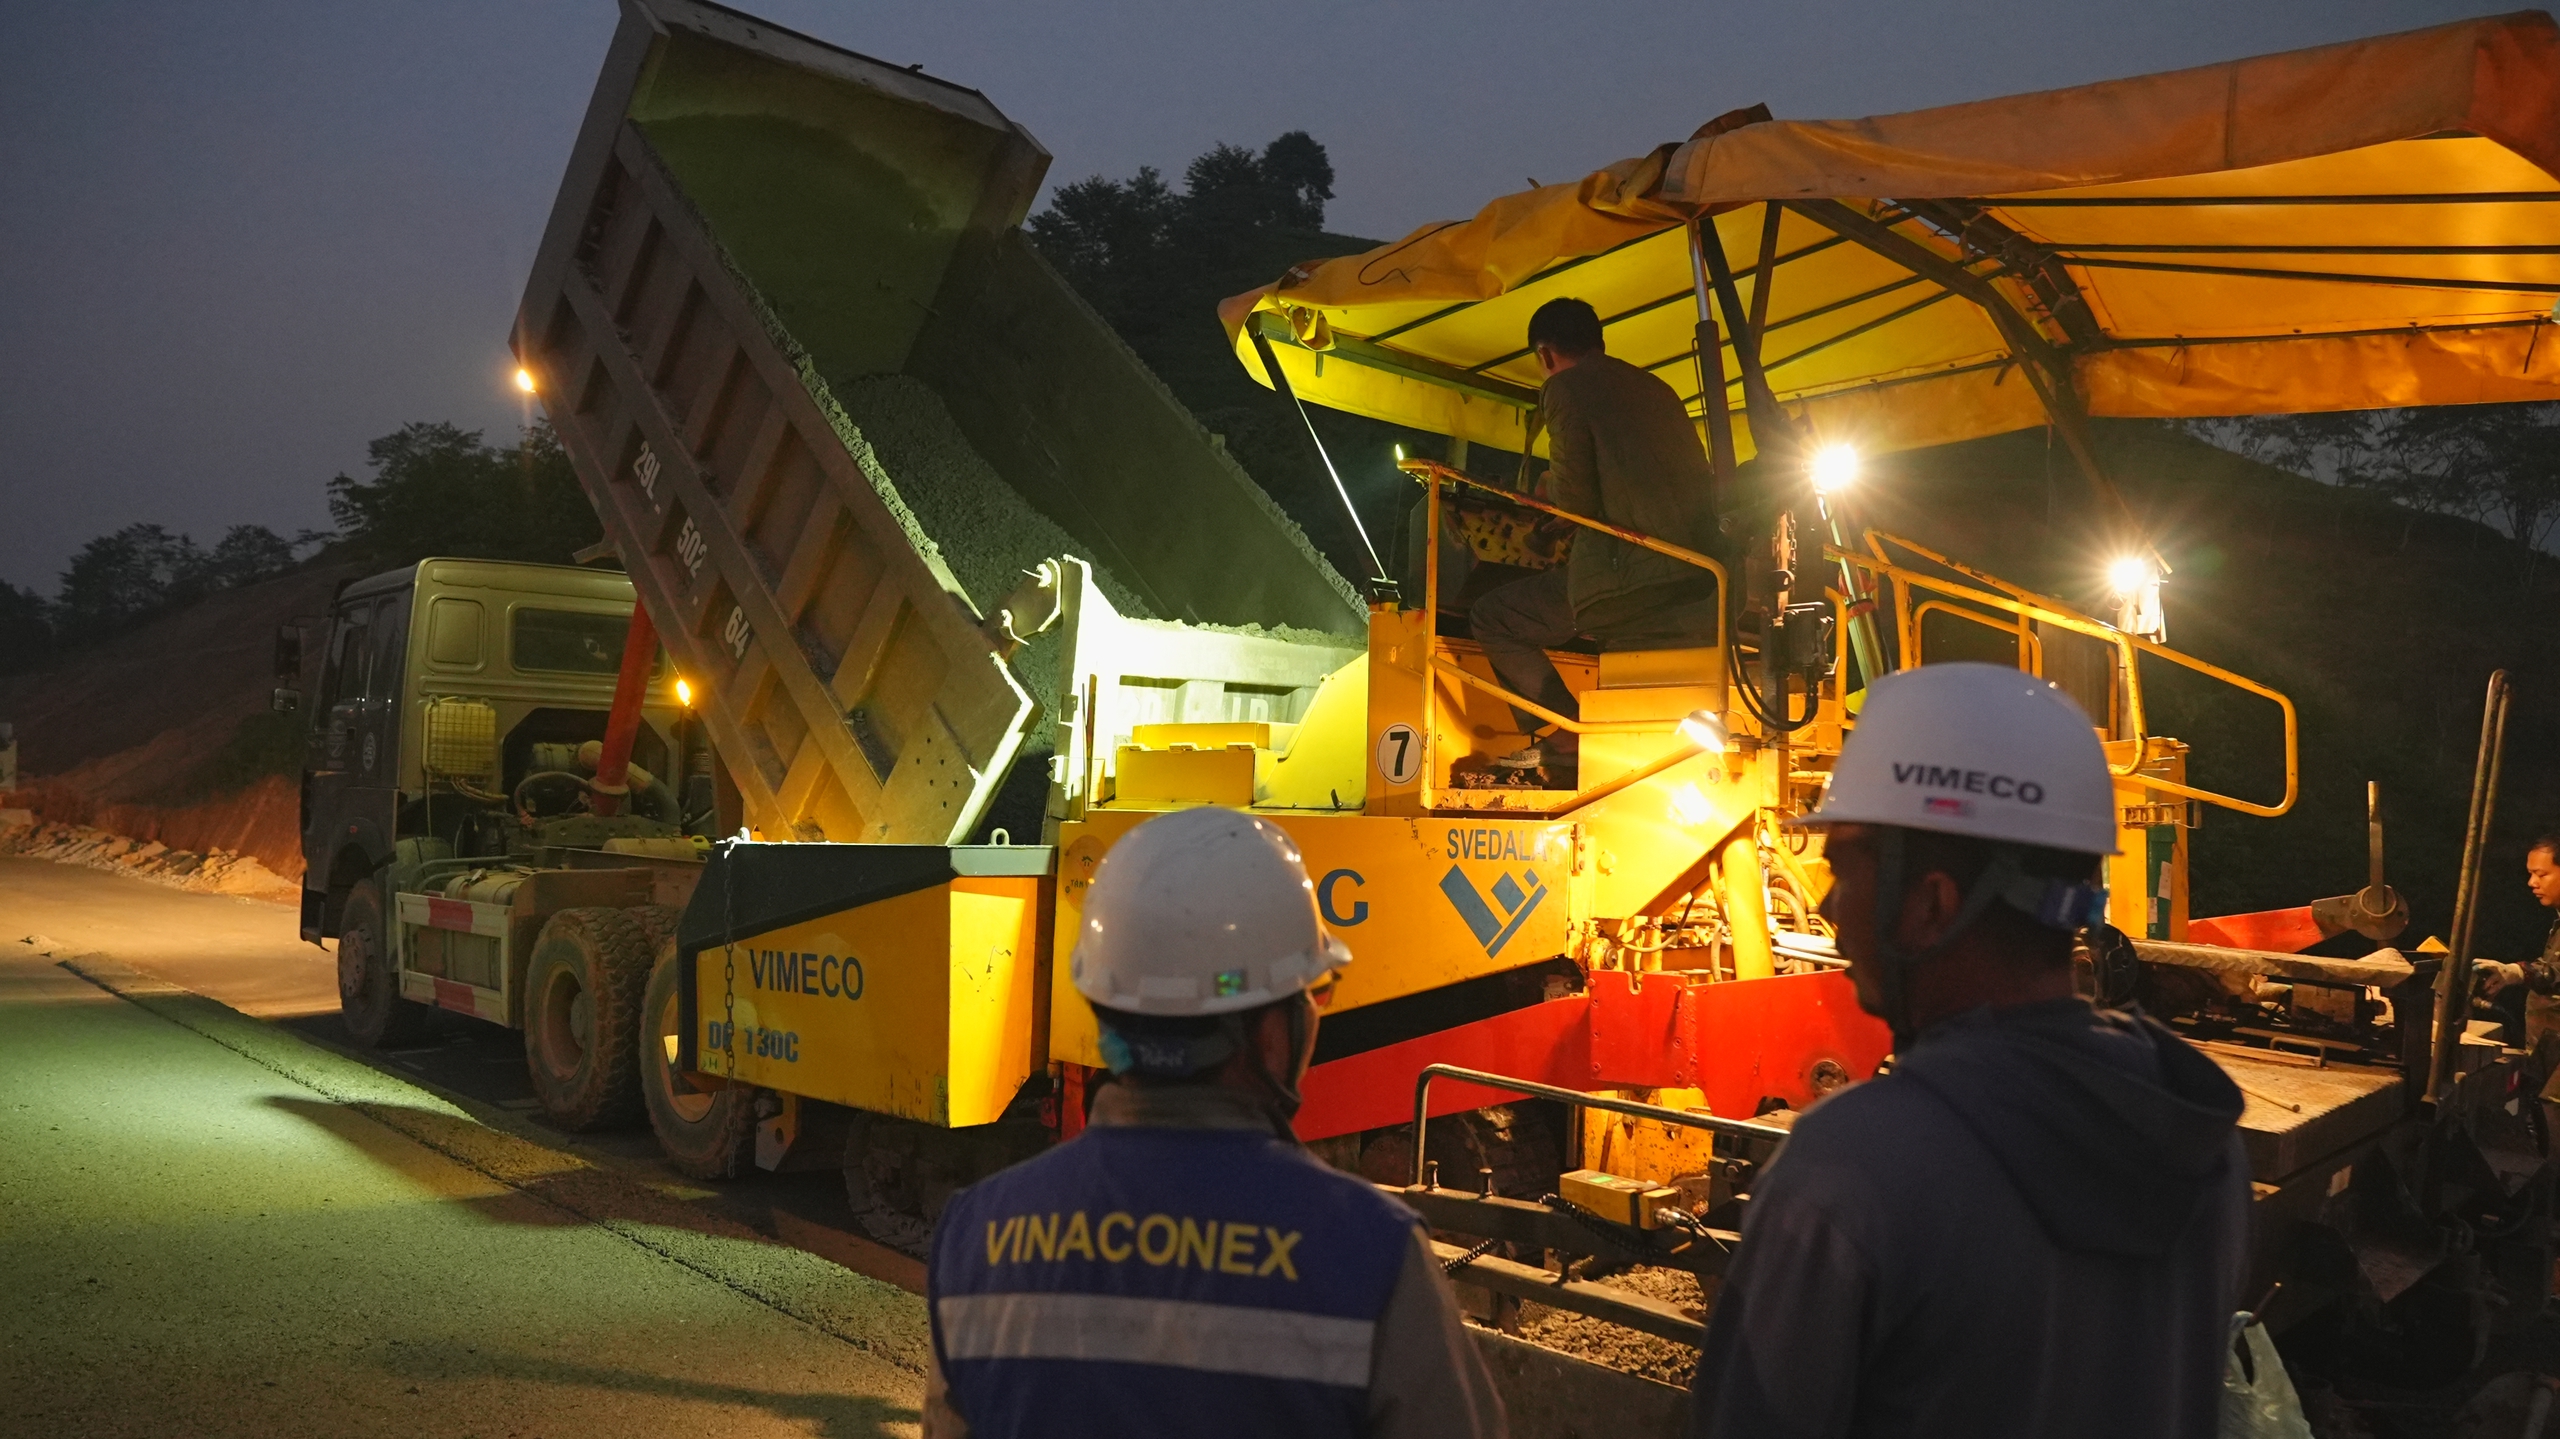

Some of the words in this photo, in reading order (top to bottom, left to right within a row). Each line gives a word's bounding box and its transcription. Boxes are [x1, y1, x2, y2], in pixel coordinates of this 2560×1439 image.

[724, 605, 750, 660] 64
[1389, 731, 1411, 777] 7
[1892, 762, 2045, 805] VIMECO
[1446, 828, 1548, 862] SVEDALA
[749, 949, 864, 1001] VIMECO
[744, 1024, 799, 1063] 130C
[985, 1210, 1302, 1282] VINACONEX
